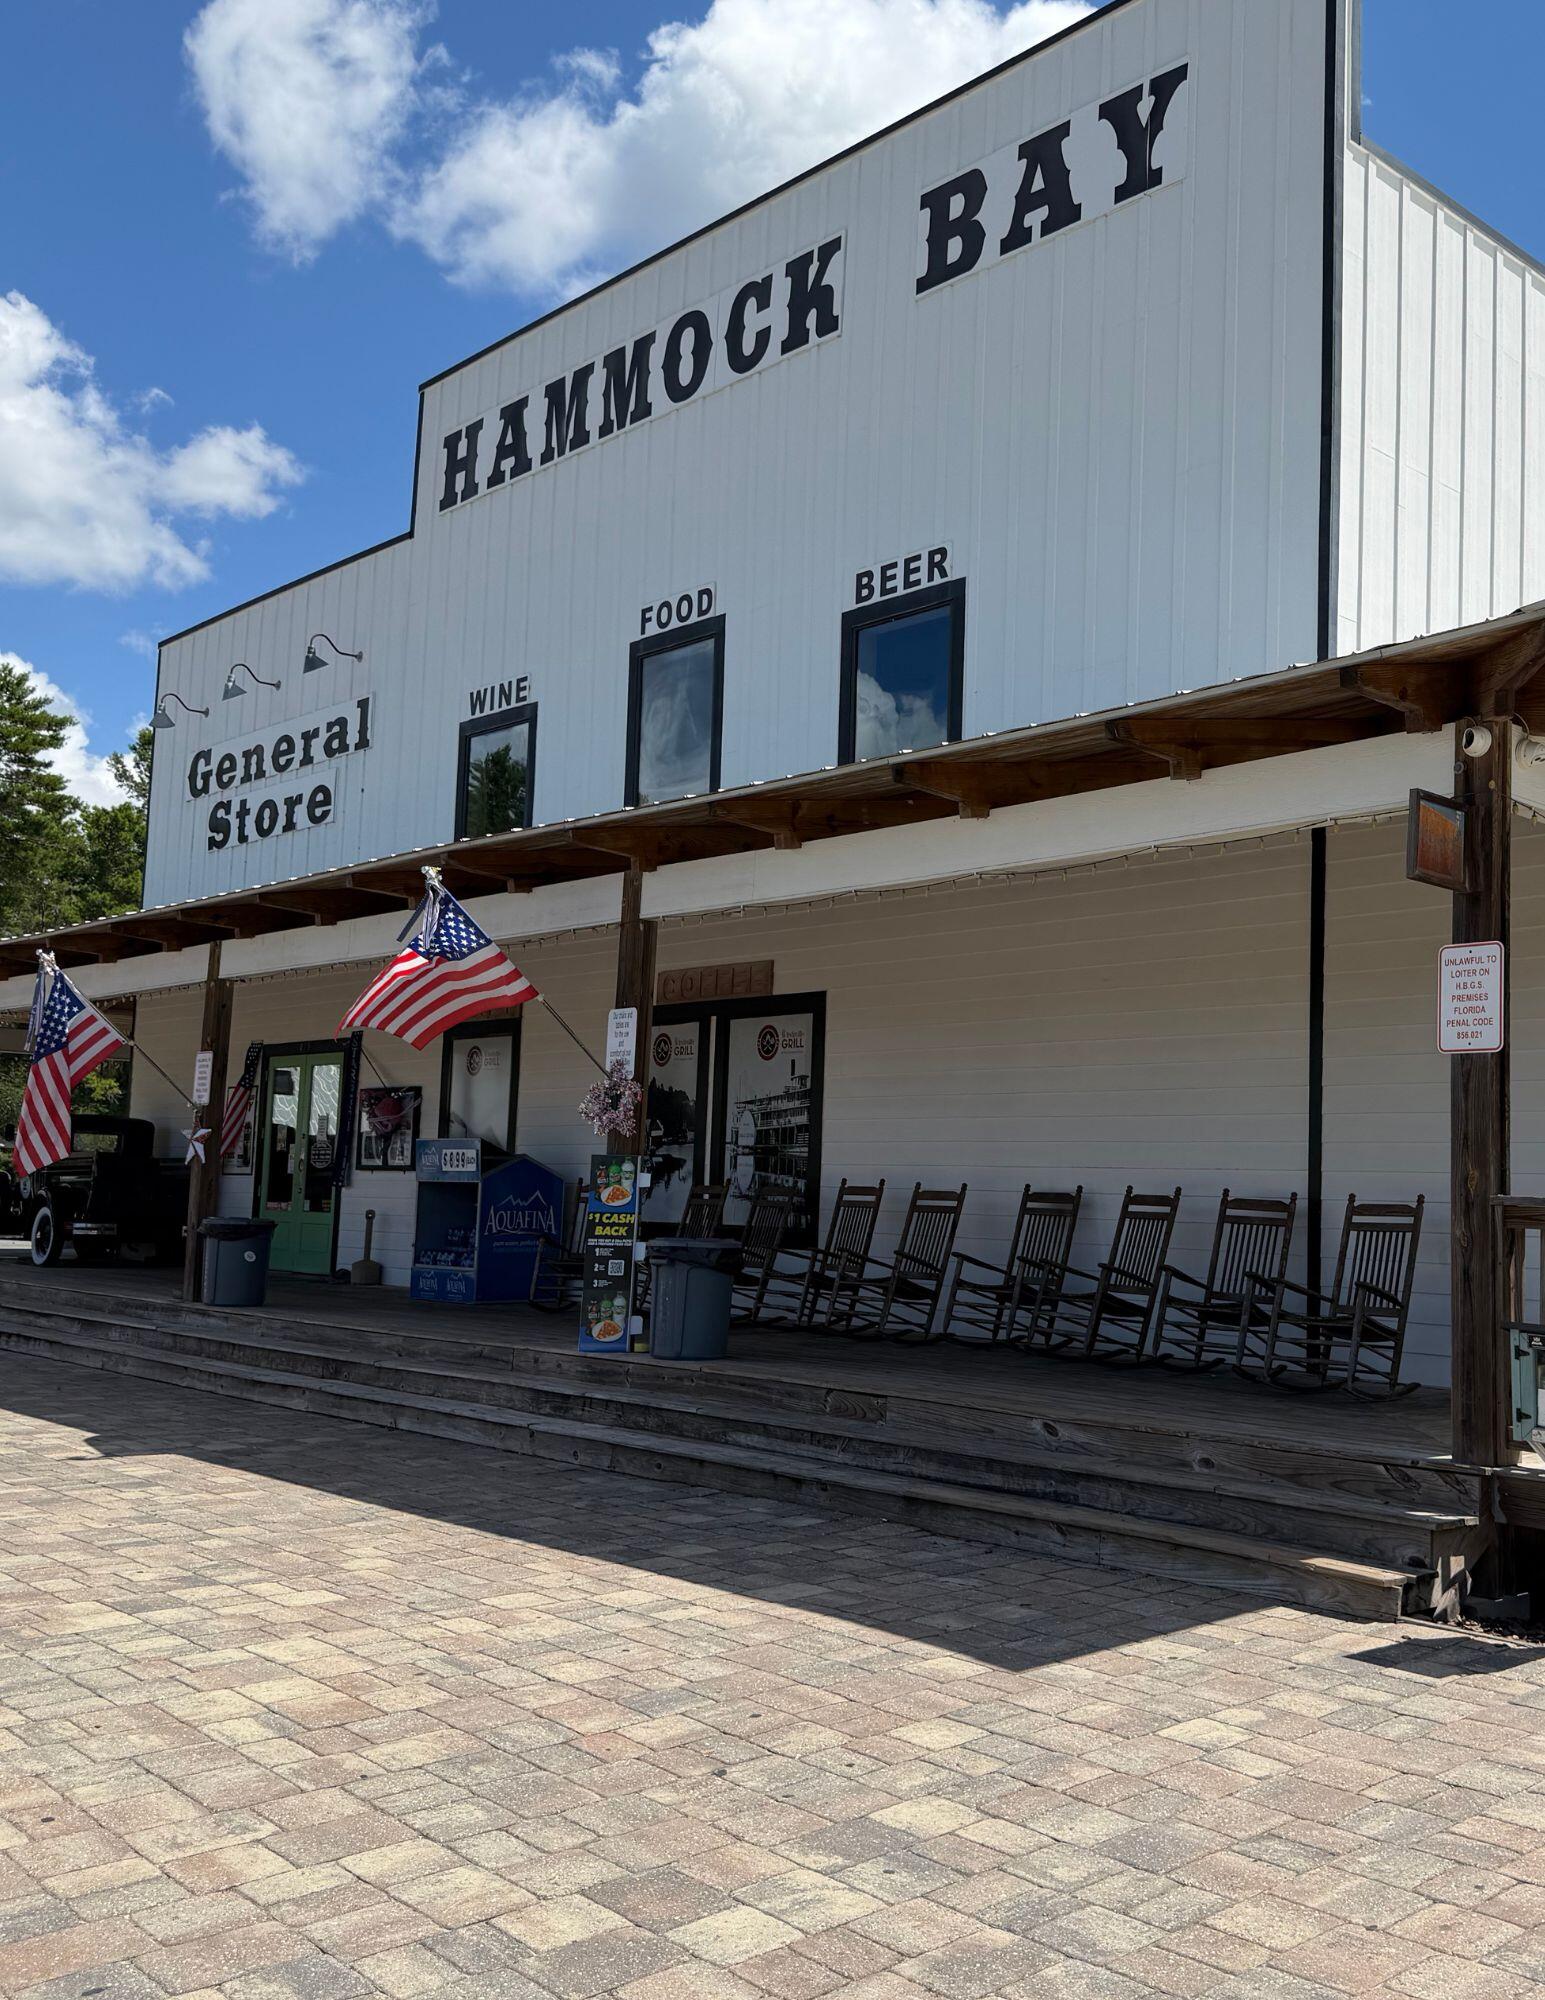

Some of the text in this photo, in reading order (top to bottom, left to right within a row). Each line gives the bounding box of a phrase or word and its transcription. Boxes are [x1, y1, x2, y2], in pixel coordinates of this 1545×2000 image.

[439, 62, 1188, 512] HAMMOCK BAY
[855, 546, 949, 605] BEER
[640, 587, 714, 636] FOOD
[469, 675, 529, 717] WINE
[187, 696, 371, 799] General
[207, 783, 332, 851] Store
[1444, 955, 1497, 967] UNLAWFUL TO
[1450, 968, 1490, 979] LOITER ON
[1455, 981, 1485, 991] H.B.G.S.
[1451, 993, 1489, 1003] PREMISES
[1453, 1005, 1487, 1015] FLORIDA
[1446, 1017, 1494, 1028] PENAL CODE
[1456, 1030, 1483, 1040] 856.021
[781, 1037, 805, 1049] GRILL
[674, 1045, 695, 1057] GRILL
[484, 1204, 557, 1236] AQUAFINA
[588, 1213, 635, 1224] $1 CASH
[594, 1225, 630, 1237] BACK
